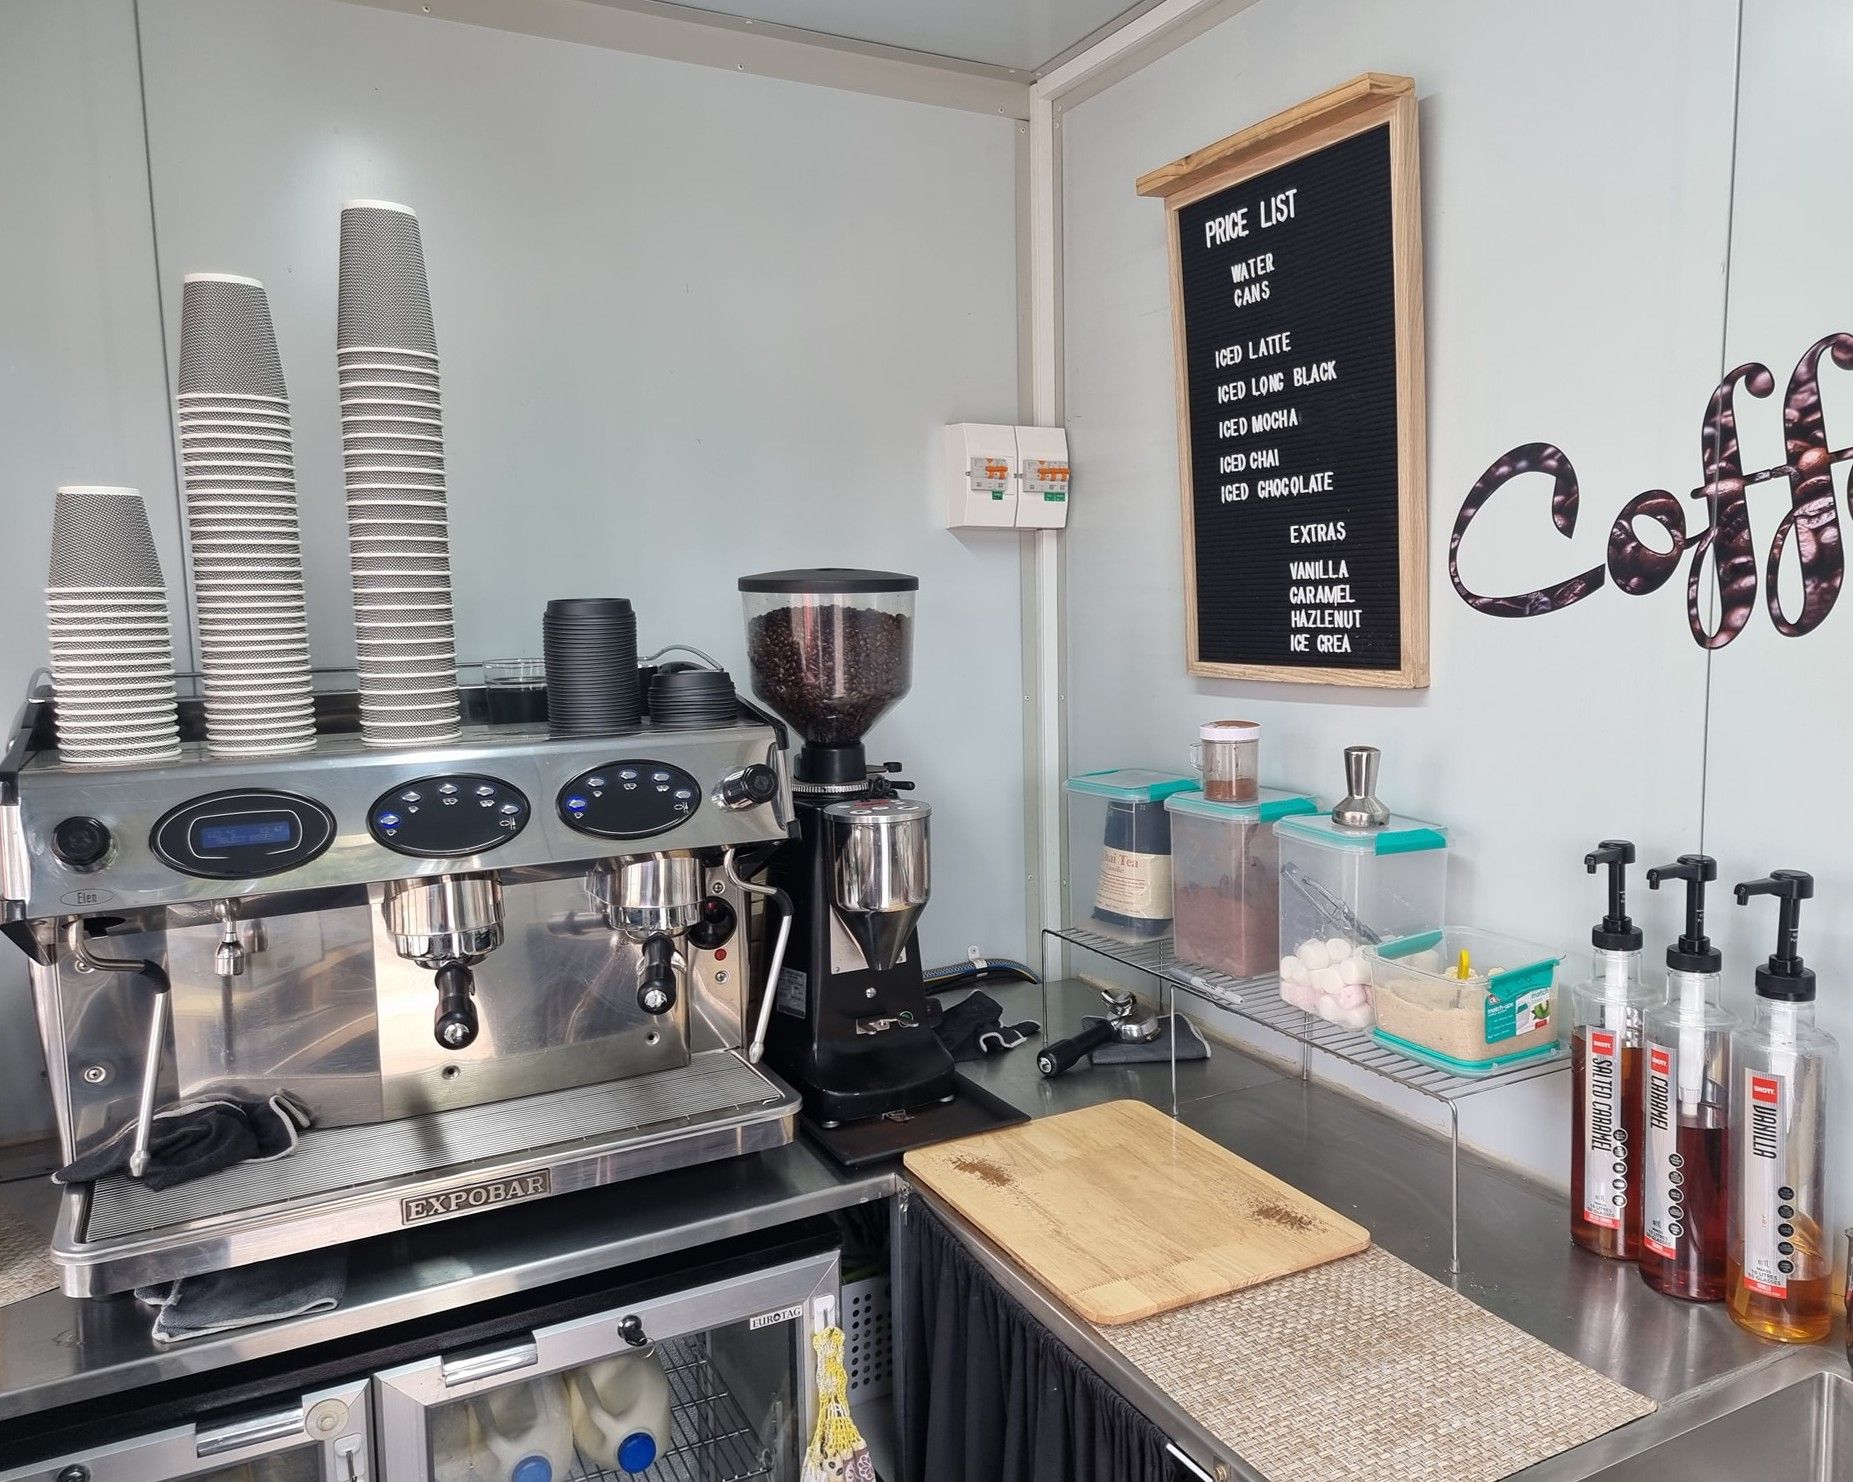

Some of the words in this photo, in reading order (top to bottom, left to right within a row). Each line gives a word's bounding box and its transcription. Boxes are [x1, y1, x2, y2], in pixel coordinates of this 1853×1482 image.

[1205, 207, 1249, 249] PRICE
[1260, 189, 1298, 229] LIST
[1231, 253, 1275, 283] WATER
[1234, 281, 1271, 308] CANS
[1215, 345, 1242, 369] ICED
[1248, 331, 1292, 360] LATTE
[1217, 380, 1246, 404] ICED
[1251, 372, 1284, 397] LONG
[1293, 360, 1338, 387] BLACK
[1219, 417, 1248, 439] ICED
[1251, 408, 1299, 435] MOCHA
[1220, 453, 1247, 474] ICED
[1250, 449, 1280, 469] CHAI
[1221, 482, 1249, 504] ICED
[1257, 471, 1334, 499] CHOCOLATE
[1449, 332, 1853, 650] Coff
[1290, 522, 1347, 544] EXTRAS
[1289, 560, 1349, 580] VANILLA
[1289, 584, 1355, 607] CARAMEL
[1291, 609, 1362, 629] HAZLENUT
[1290, 634, 1310, 652] ICE
[1317, 633, 1351, 653] CREA
[1119, 854, 1139, 868] Tea
[77, 892, 97, 904] Elen
[1592, 1057, 1613, 1100] SALTED
[1650, 1075, 1669, 1131] CARAMEL
[1591, 1100, 1613, 1152] CARAMEL
[1752, 1104, 1777, 1159] VANILLA
[408, 1176, 545, 1220] EXPOBAR
[753, 1307, 801, 1328] EUROTAG
